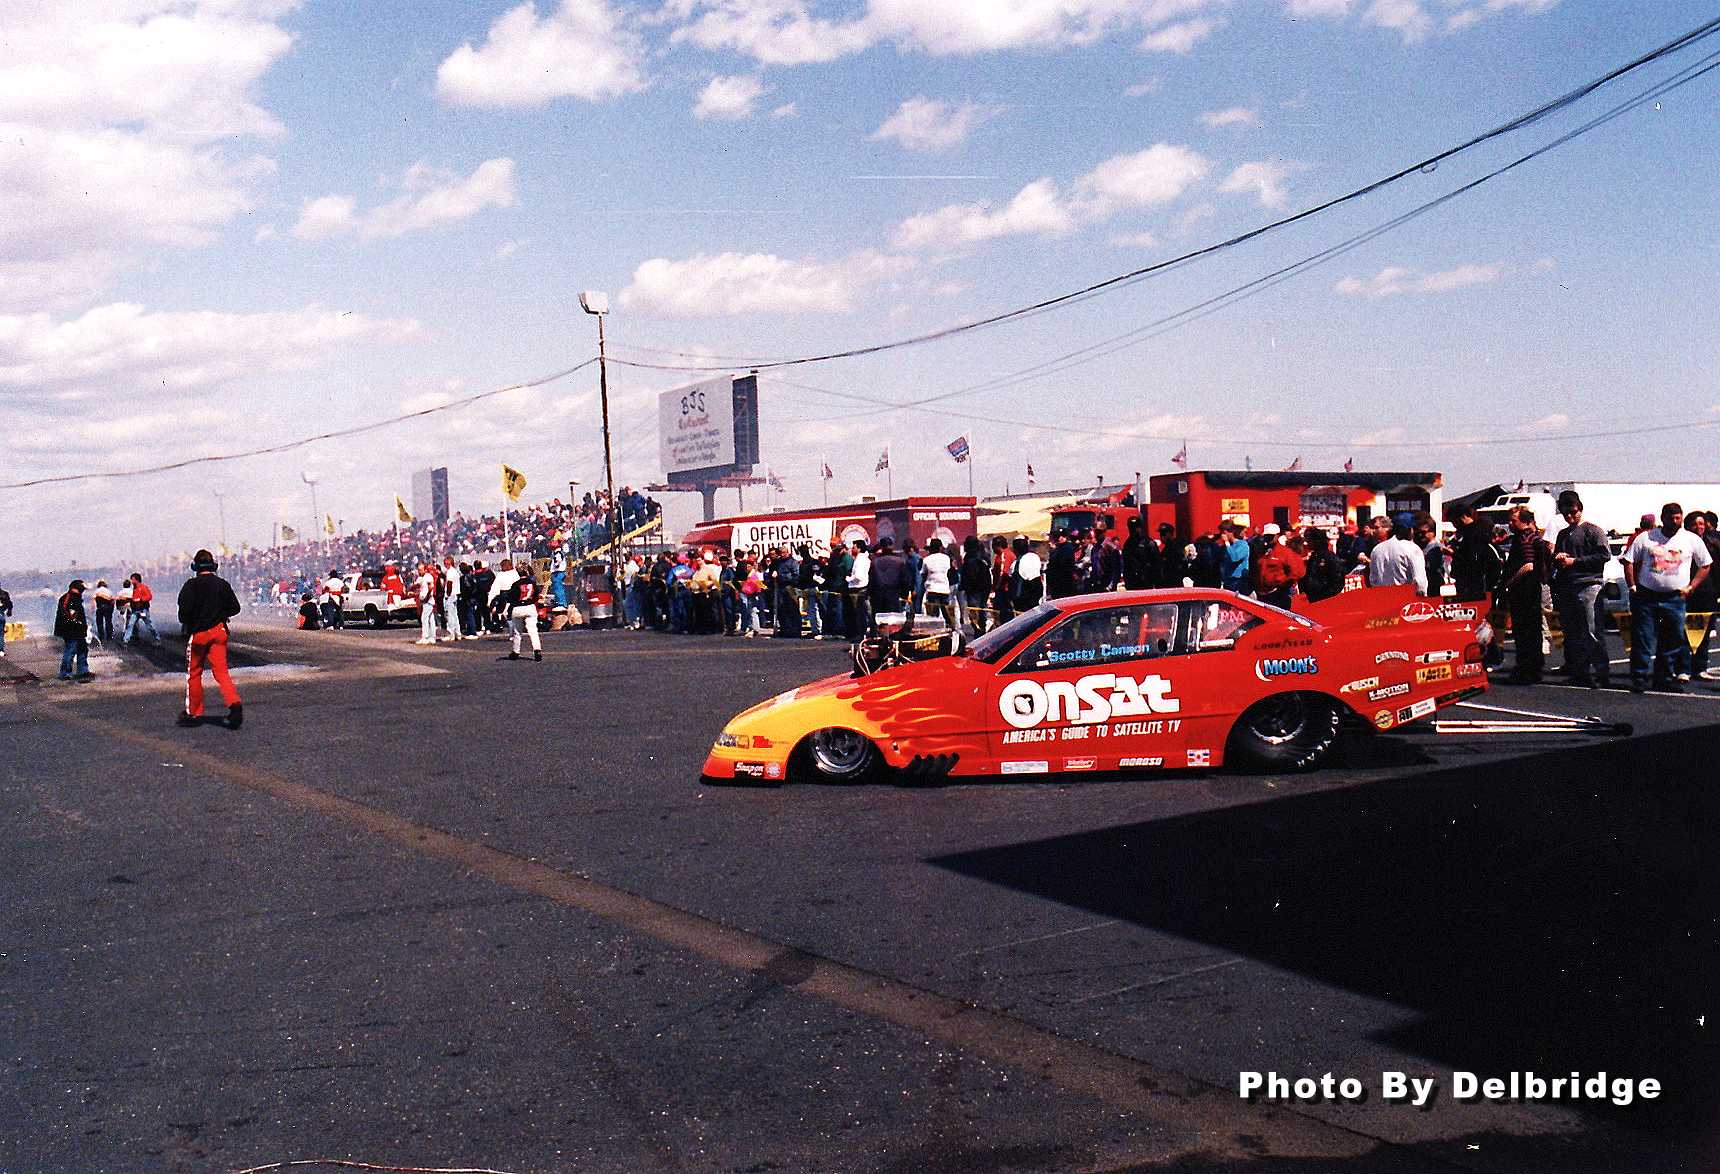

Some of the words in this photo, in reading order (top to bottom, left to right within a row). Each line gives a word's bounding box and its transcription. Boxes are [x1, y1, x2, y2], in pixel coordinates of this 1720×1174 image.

[749, 524, 813, 542] OFFICIAL
[1444, 608, 1475, 619] WELD
[1049, 648, 1095, 663] Scotty
[1002, 728, 1056, 744] AMERICA'S
[1061, 726, 1090, 740] GUIDE
[1096, 724, 1108, 737] TO
[1113, 721, 1163, 737] SATELLITE
[1168, 719, 1182, 733] TV
